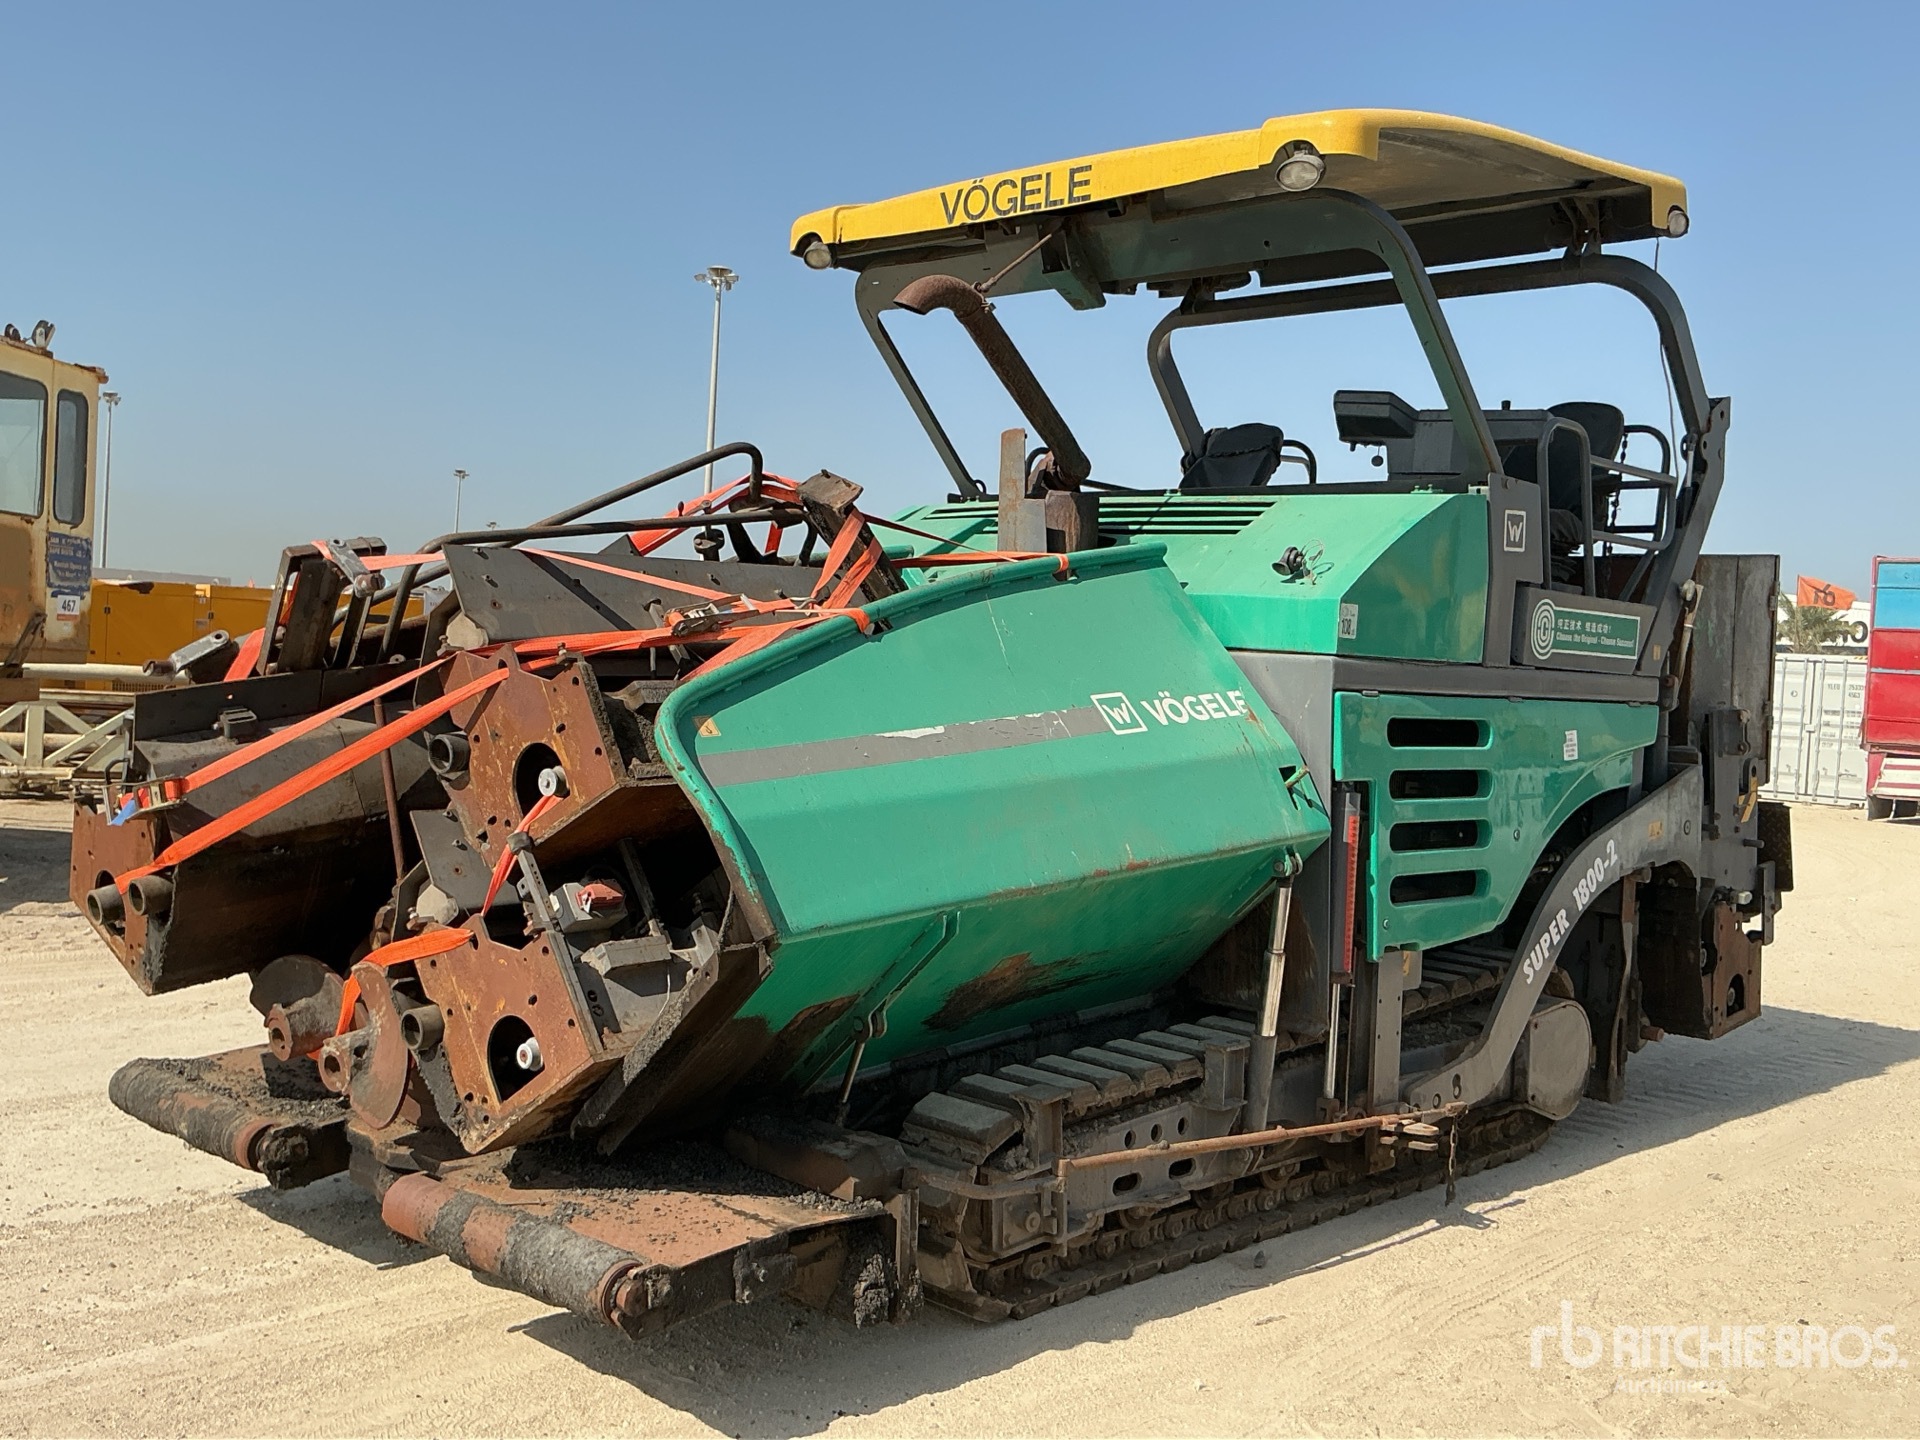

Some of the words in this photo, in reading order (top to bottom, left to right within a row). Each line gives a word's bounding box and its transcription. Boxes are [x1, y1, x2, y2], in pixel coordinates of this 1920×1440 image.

[940, 164, 1093, 226] VÖGELE
[62, 599, 76, 613] 467
[1139, 690, 1248, 726] VÖGELE
[1523, 908, 1570, 985] SUPER
[1572, 839, 1619, 912] 1800-2
